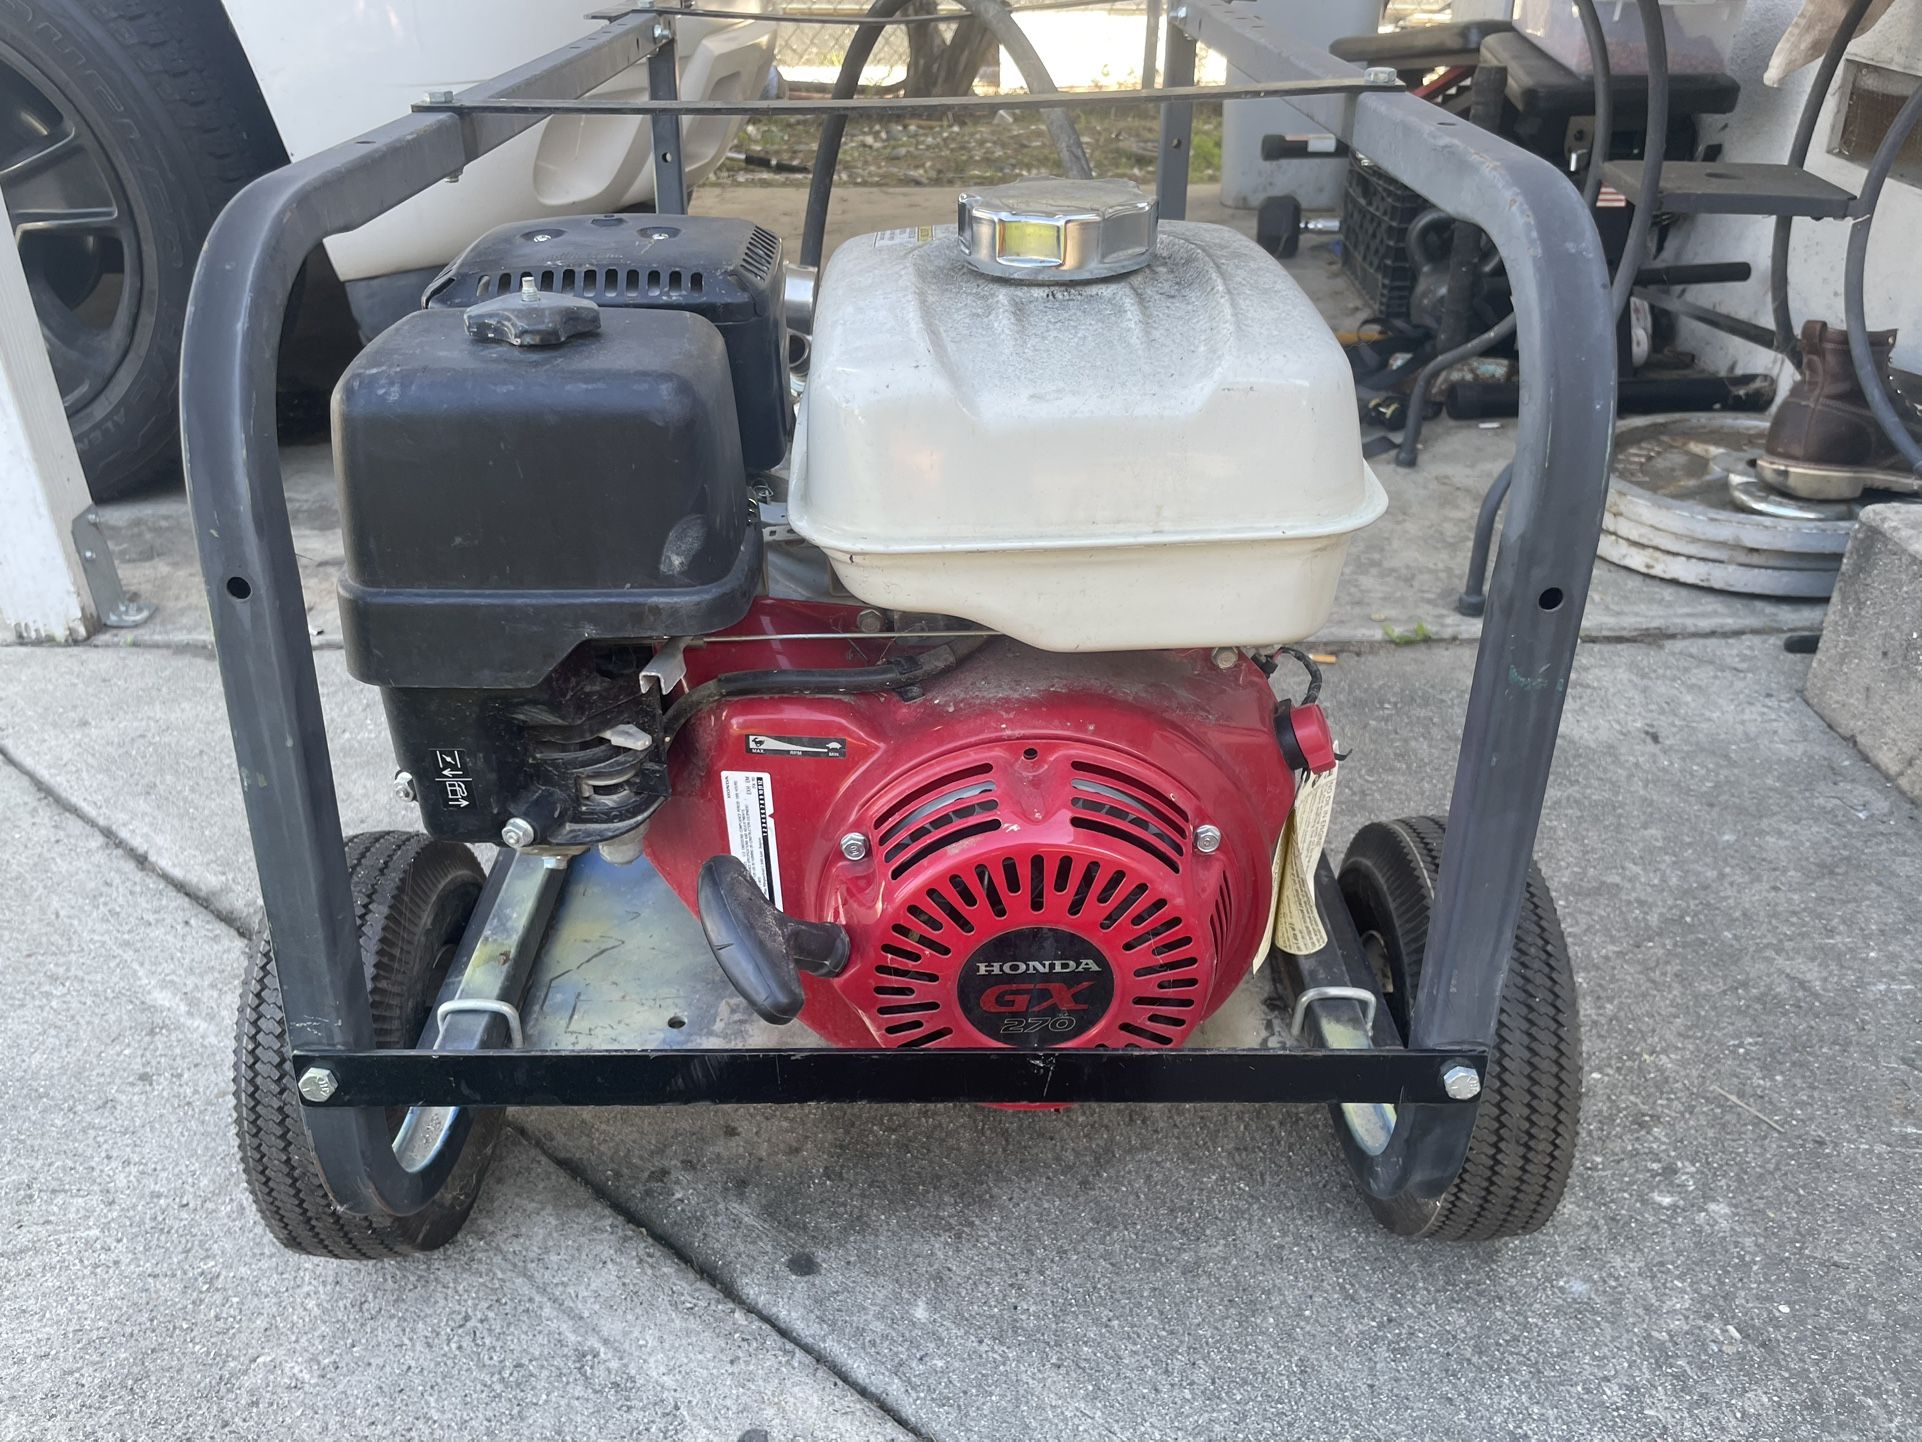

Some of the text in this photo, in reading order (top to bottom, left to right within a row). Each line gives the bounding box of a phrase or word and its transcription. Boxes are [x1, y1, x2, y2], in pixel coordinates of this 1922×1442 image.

[976, 959, 1102, 976] HONDA
[979, 981, 1097, 1014] GX
[1000, 1016, 1076, 1034] 270
